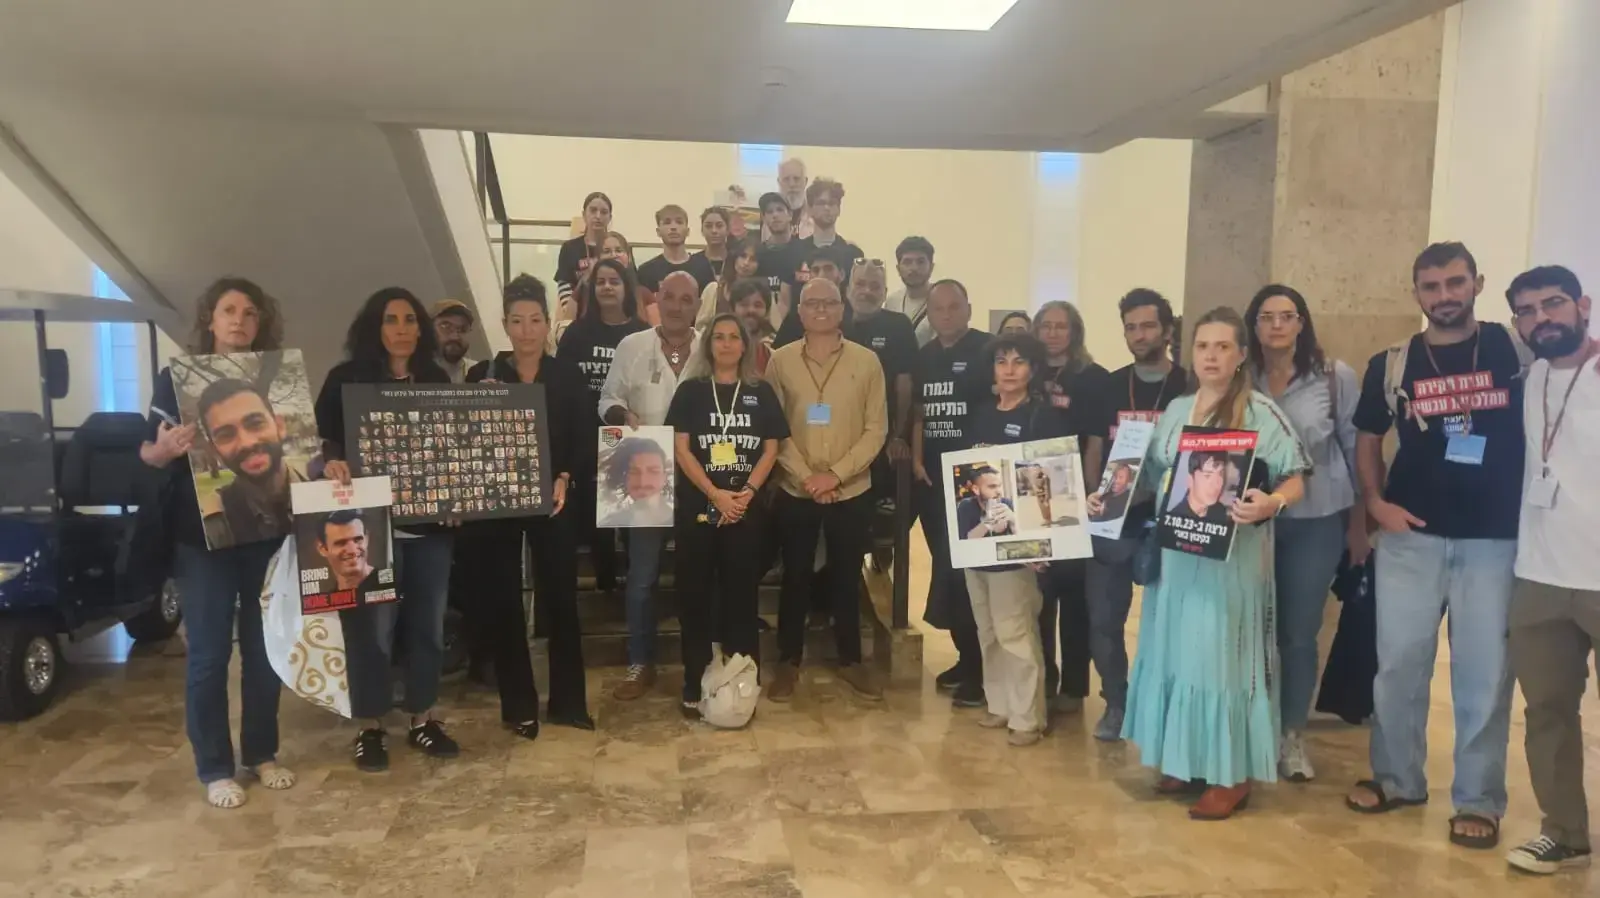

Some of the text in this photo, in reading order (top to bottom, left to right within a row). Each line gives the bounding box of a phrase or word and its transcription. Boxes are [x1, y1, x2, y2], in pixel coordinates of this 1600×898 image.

[593, 346, 616, 358] מרו
[923, 382, 954, 396] נגמרו
[923, 402, 968, 416] התירוצ
[710, 412, 751, 427] נגמרו
[1204, 522, 1228, 537] נרצח
[301, 567, 329, 582] BRING
[302, 581, 320, 595] HIM
